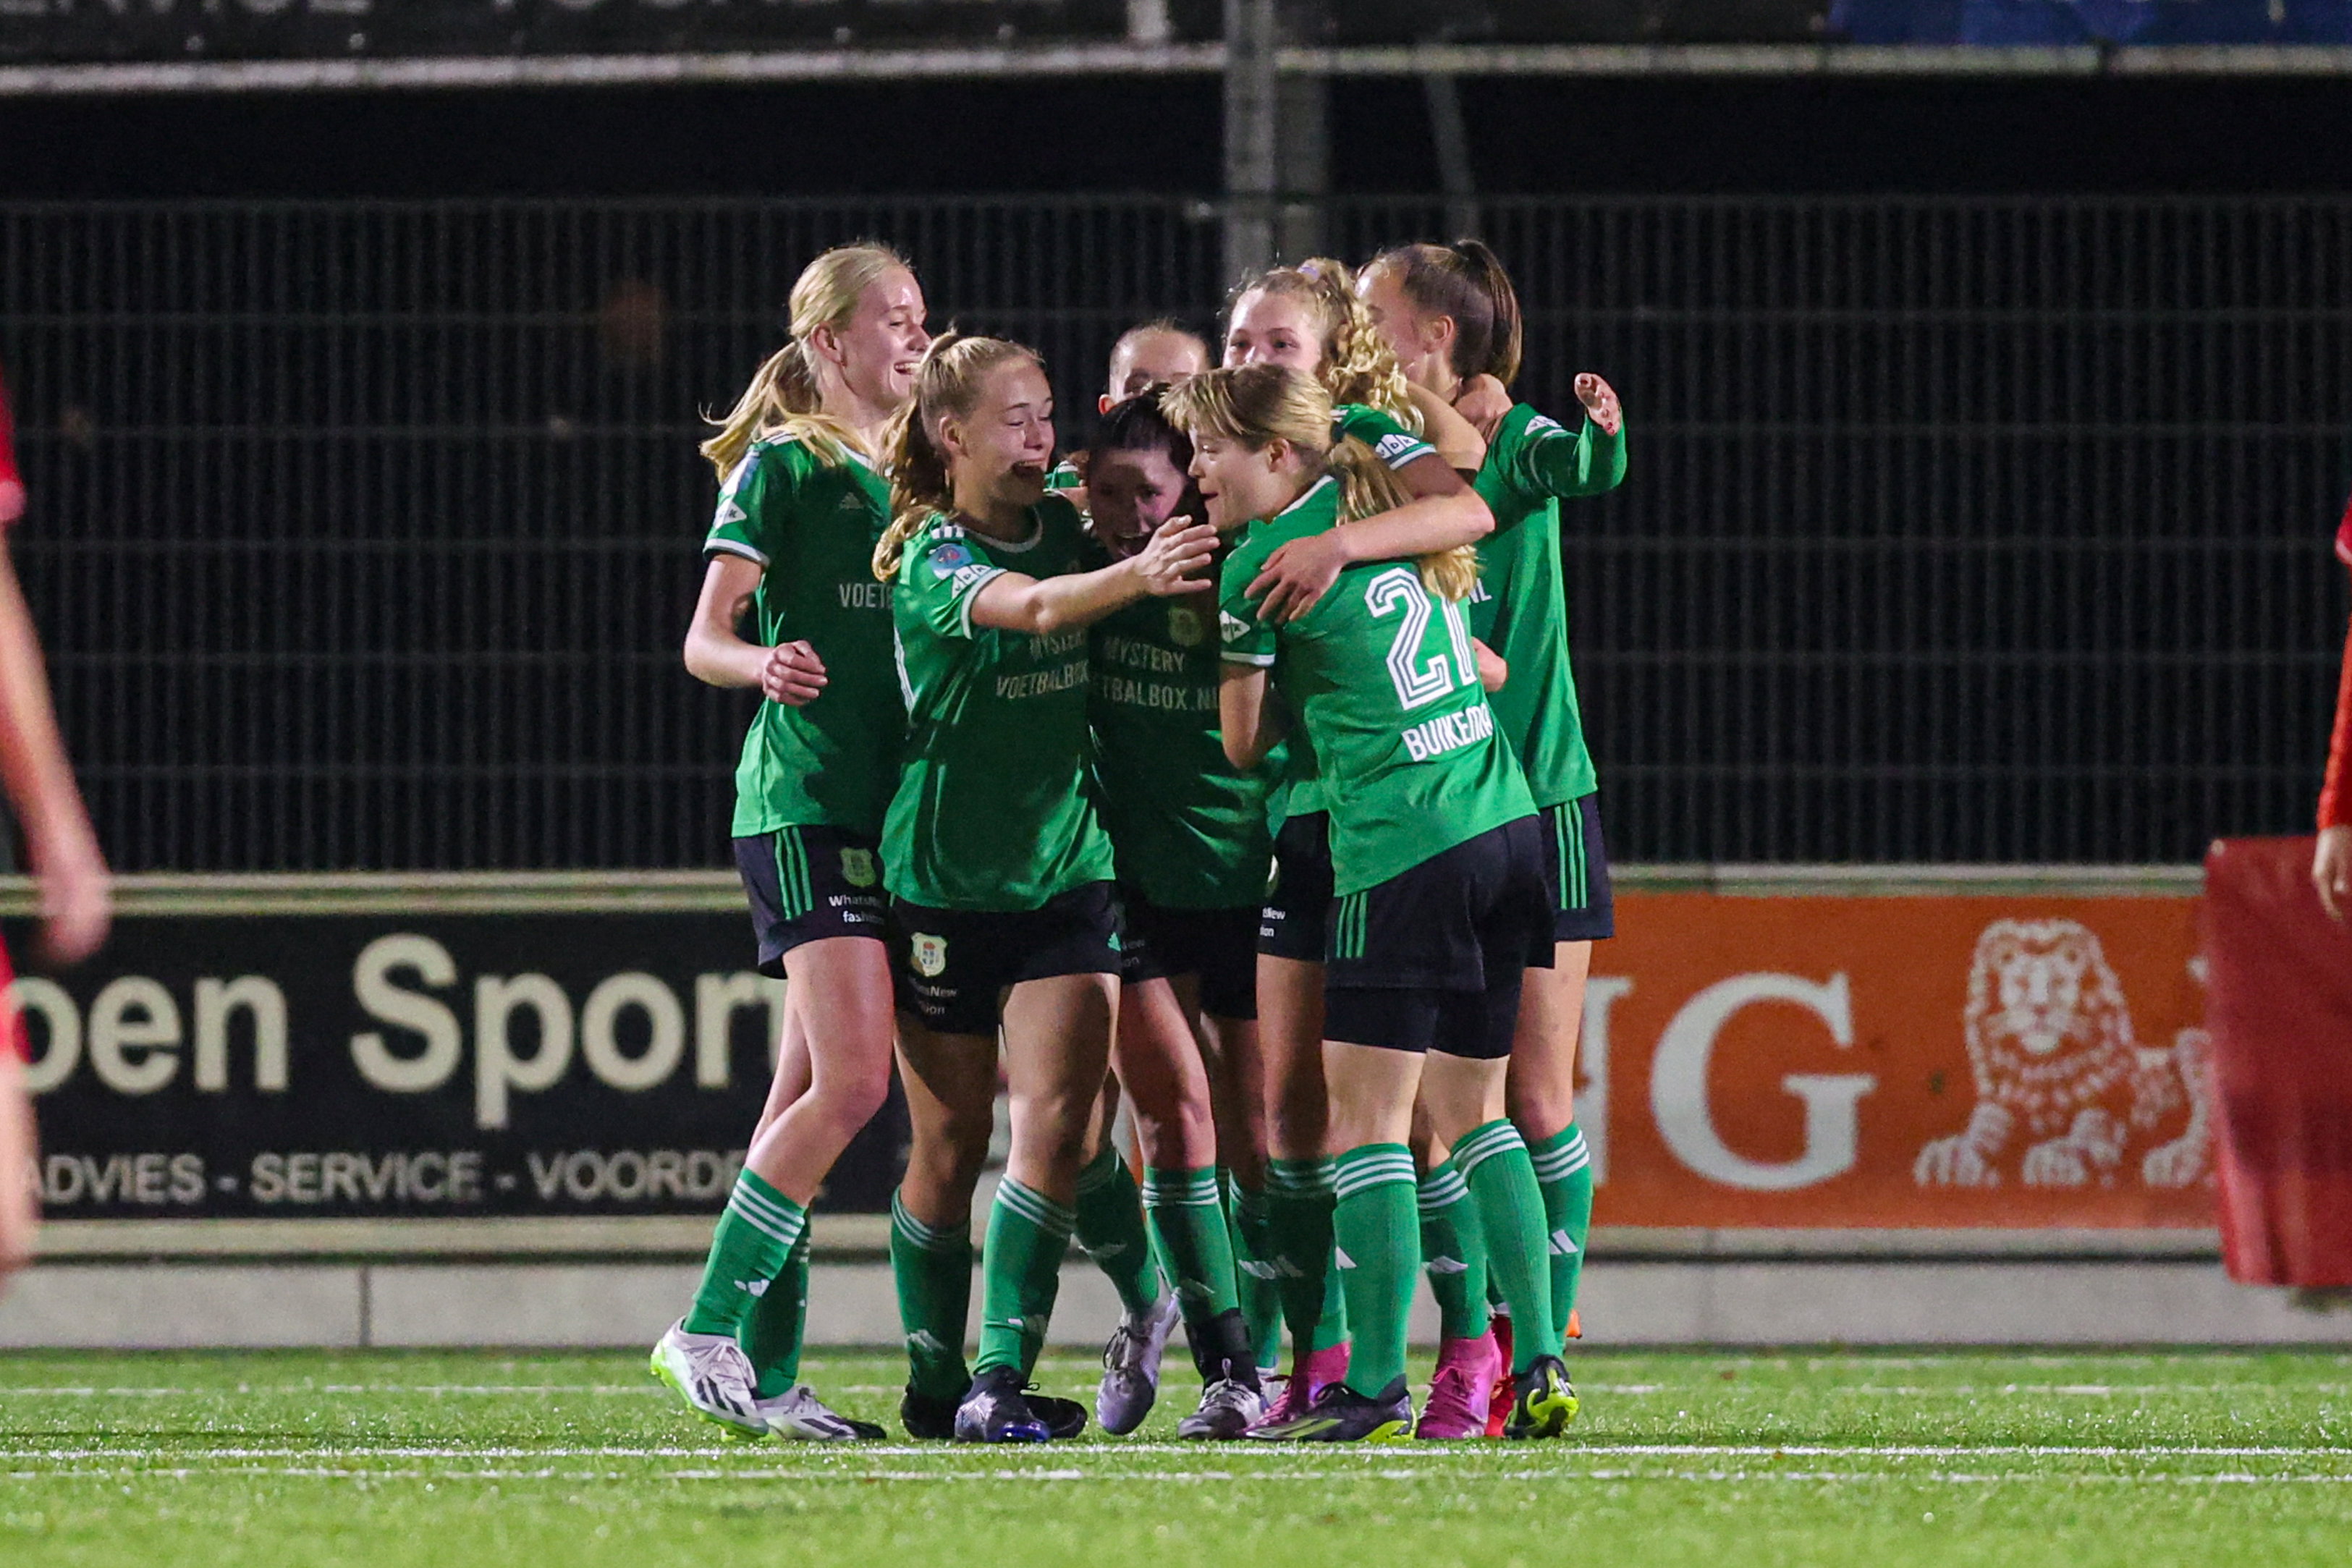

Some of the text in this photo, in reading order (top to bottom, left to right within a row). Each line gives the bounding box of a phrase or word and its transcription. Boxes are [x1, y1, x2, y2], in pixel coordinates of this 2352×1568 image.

[1104, 635, 1186, 673] MYSTERY
[1364, 567, 1478, 711] 21
[1401, 703, 1494, 762] BUIKEMA
[250, 1152, 484, 1203] SERVICE
